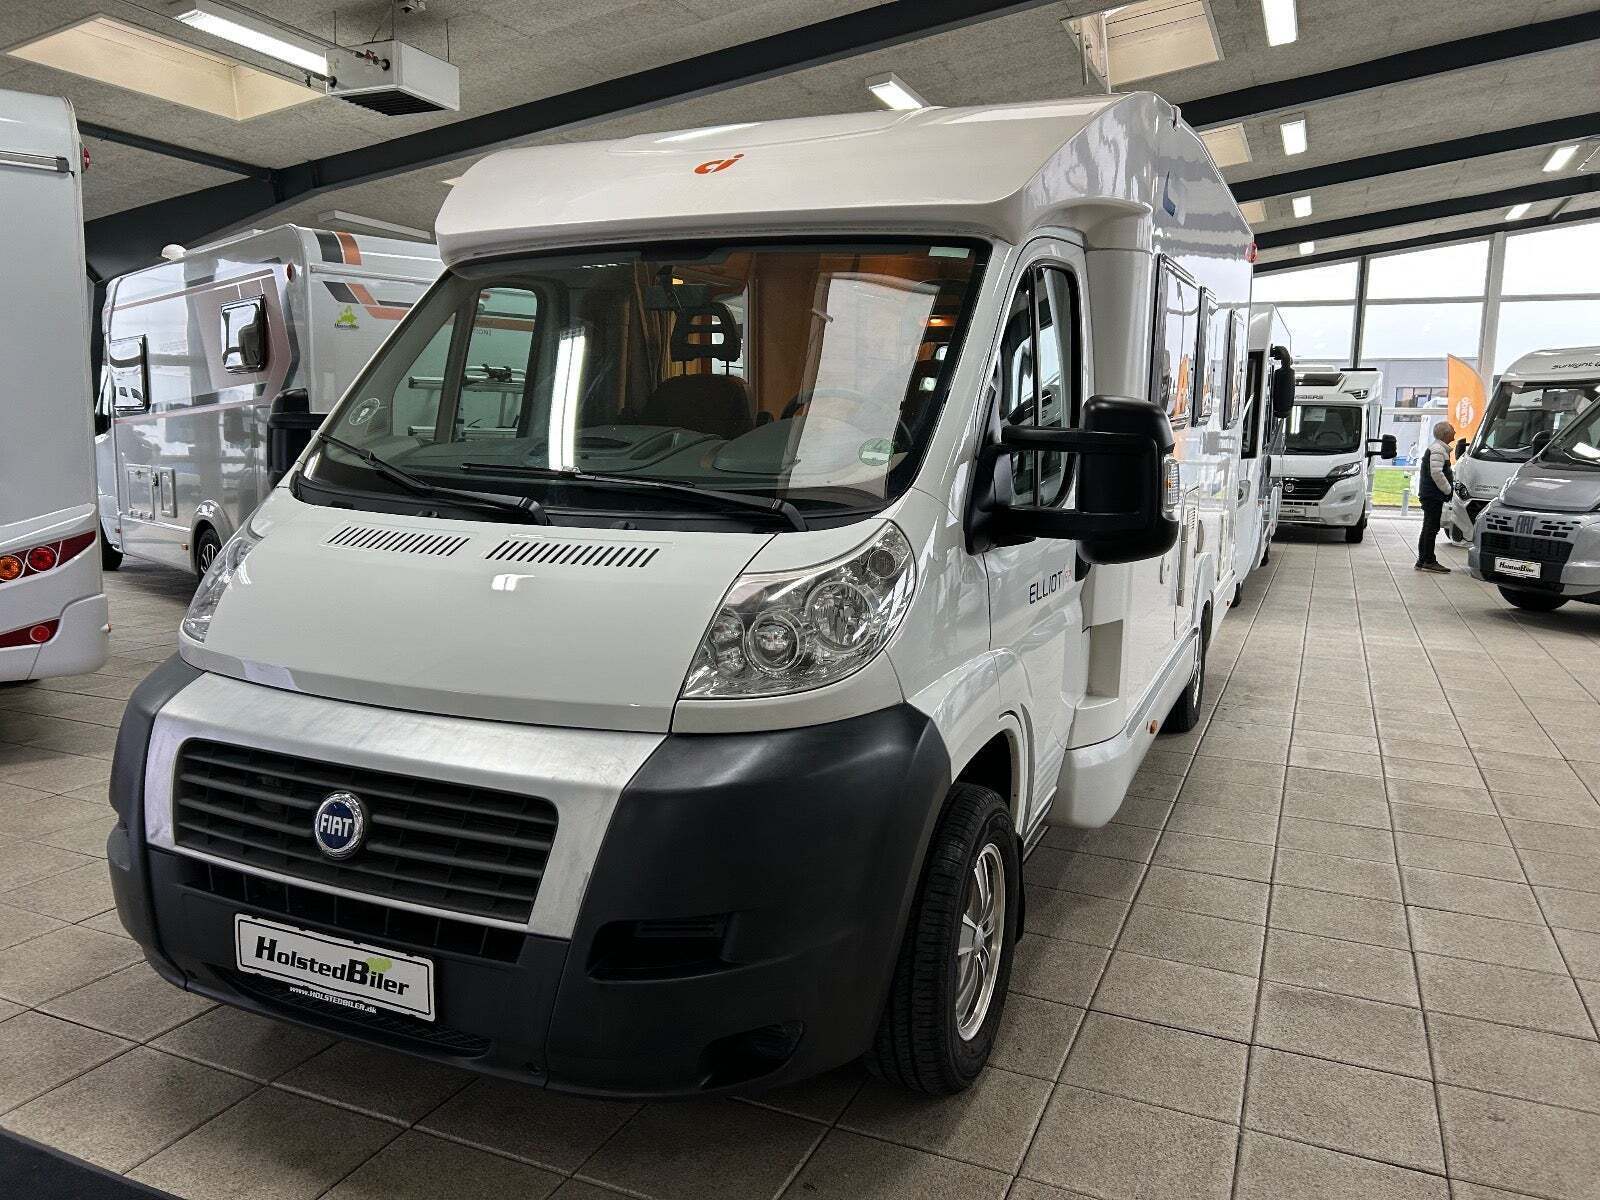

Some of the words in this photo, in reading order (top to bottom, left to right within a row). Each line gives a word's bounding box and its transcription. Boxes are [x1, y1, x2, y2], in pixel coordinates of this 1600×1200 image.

[1514, 515, 1537, 535] FIAT
[1029, 569, 1064, 605] ELLIOT
[319, 813, 353, 838] FIAT
[254, 935, 410, 996] HolstedBiler
[289, 985, 378, 1014] www.HOLSTEDBILER.dk
